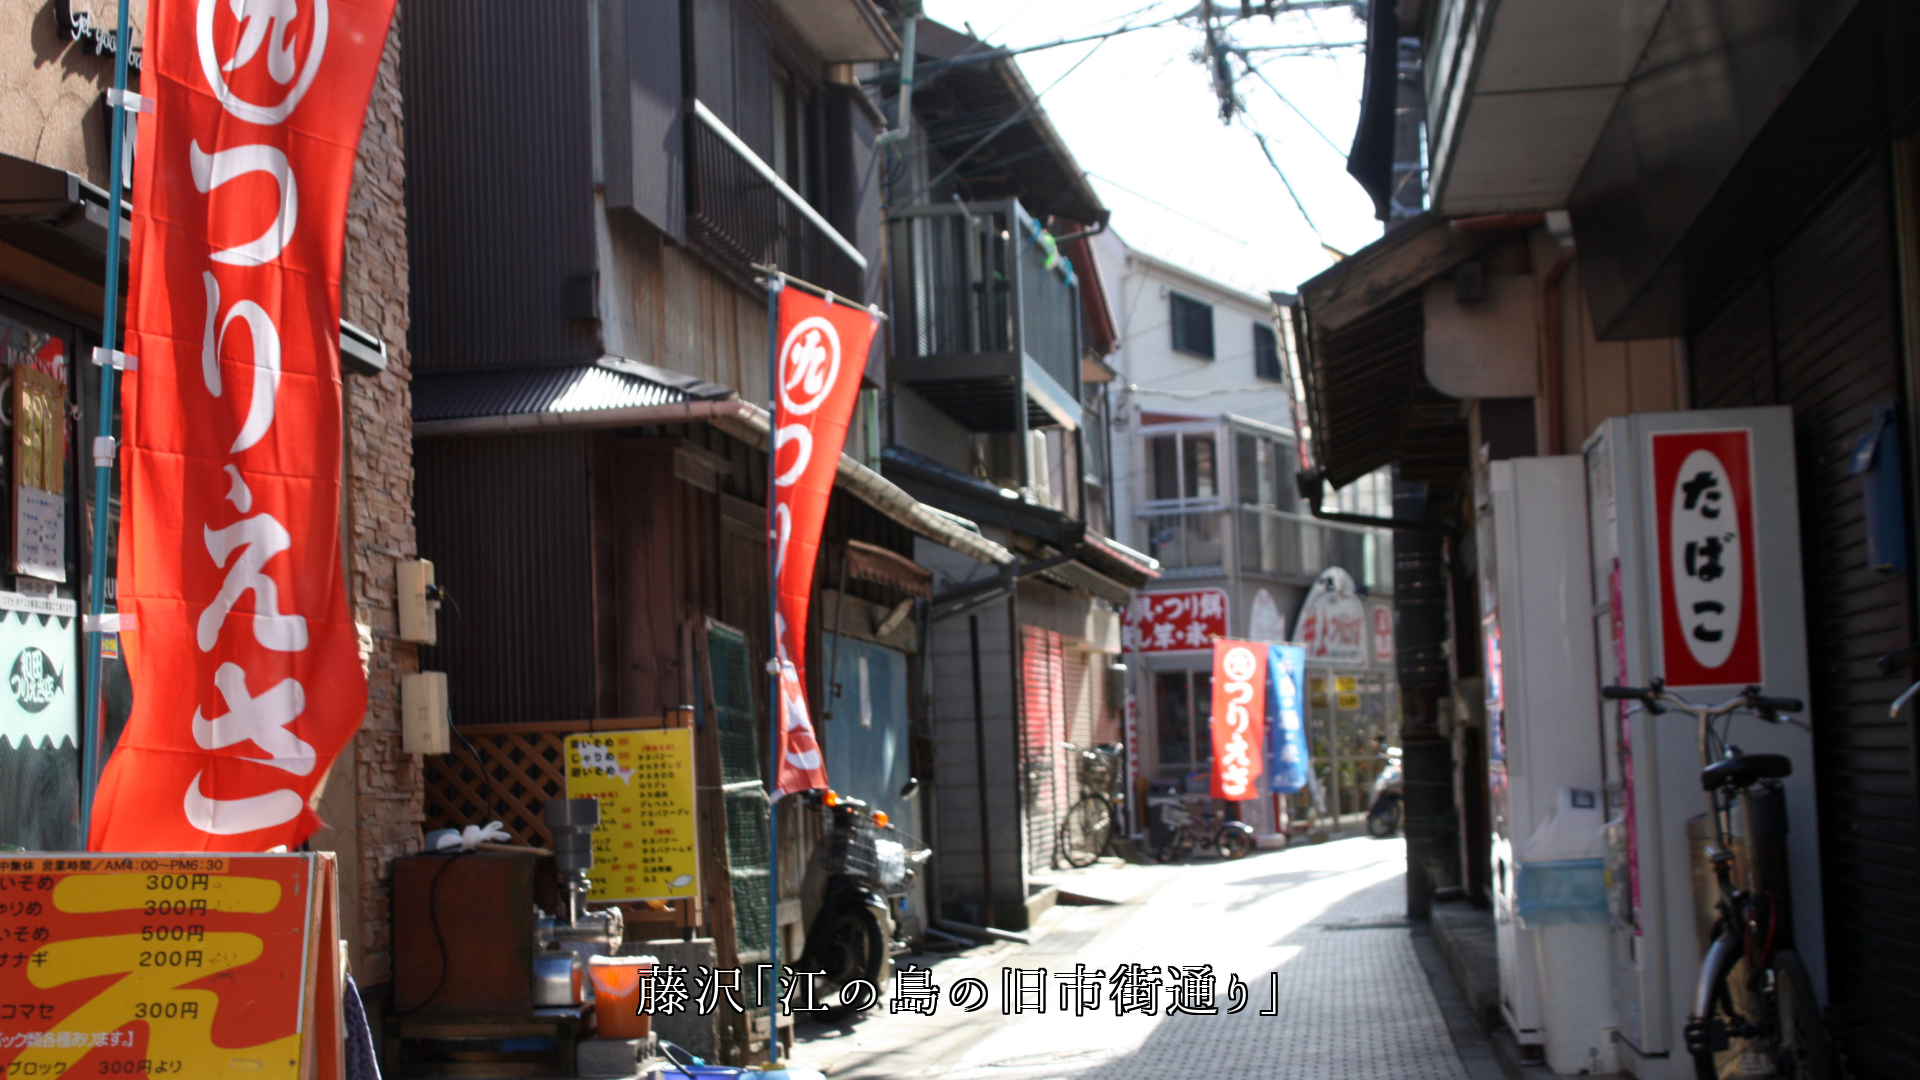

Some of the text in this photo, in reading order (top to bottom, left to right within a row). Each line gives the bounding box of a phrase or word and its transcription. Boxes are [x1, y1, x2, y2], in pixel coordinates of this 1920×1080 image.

[184, 133, 317, 835] つりえさ
[1680, 470, 1734, 643] たばこ
[1221, 681, 1254, 796] つりえさ
[146, 874, 209, 891] 300円
[143, 899, 207, 916] 300円
[141, 924, 205, 942] 500円
[139, 950, 203, 967] 200円
[1, 1002, 199, 1020] コマセ 300円
[0, 1060, 183, 1076] ブロック 300円より
